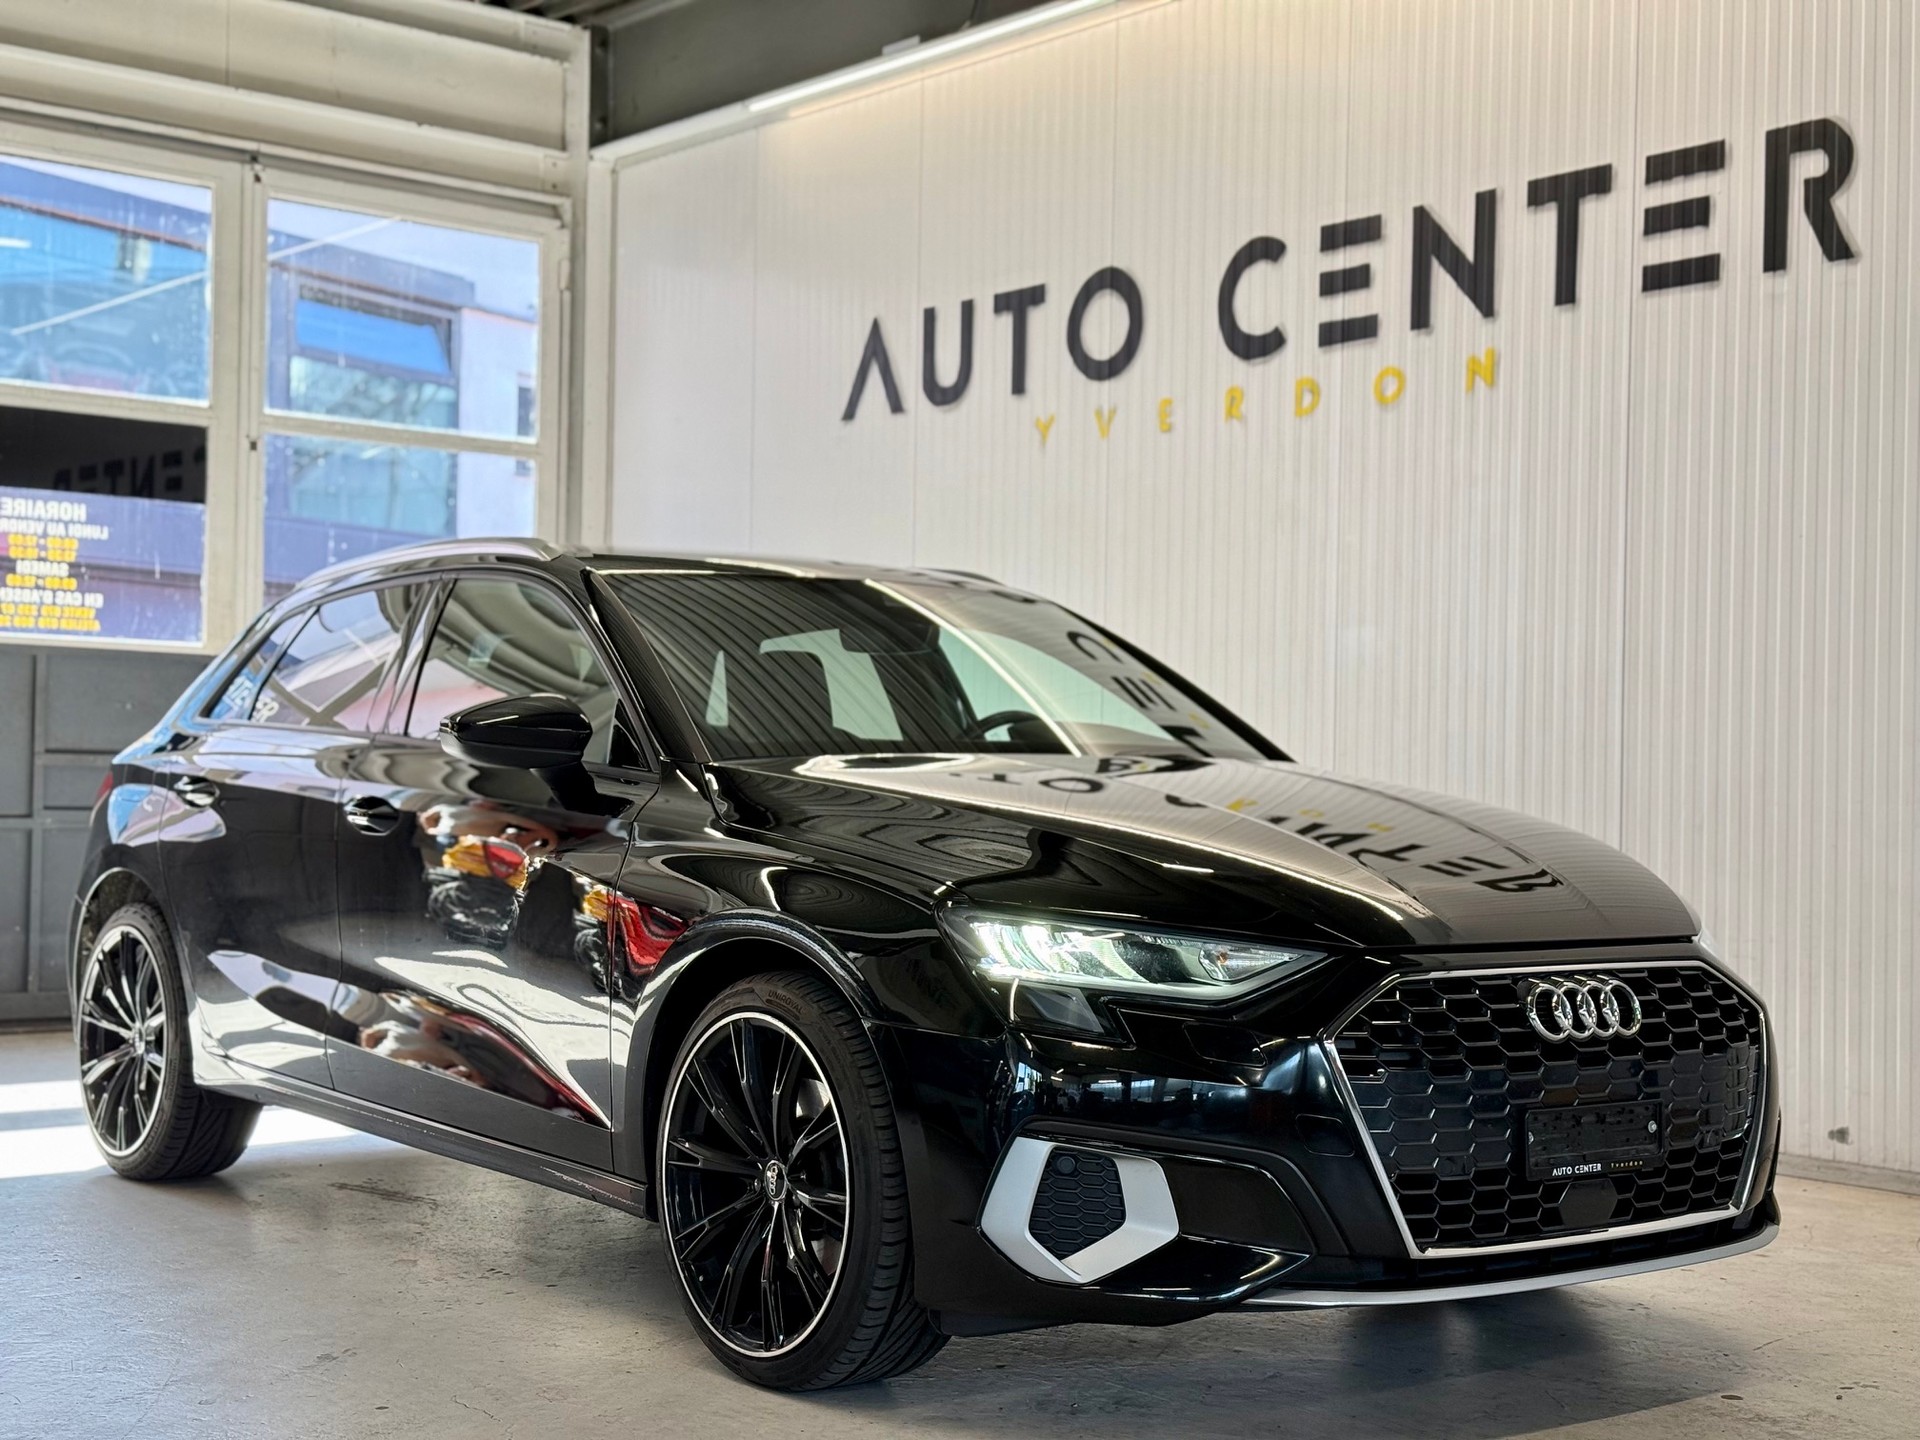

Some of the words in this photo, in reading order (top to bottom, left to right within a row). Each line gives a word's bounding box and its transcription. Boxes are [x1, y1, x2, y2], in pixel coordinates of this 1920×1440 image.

[841, 266, 1143, 421] AUTO
[1218, 117, 1855, 362] CENTER
[1036, 348, 1495, 444] YVERDON
[768, 990, 803, 1014] UNIROYAL
[1552, 1166, 1573, 1176] AUTO
[1574, 1163, 1602, 1173] CENTER
